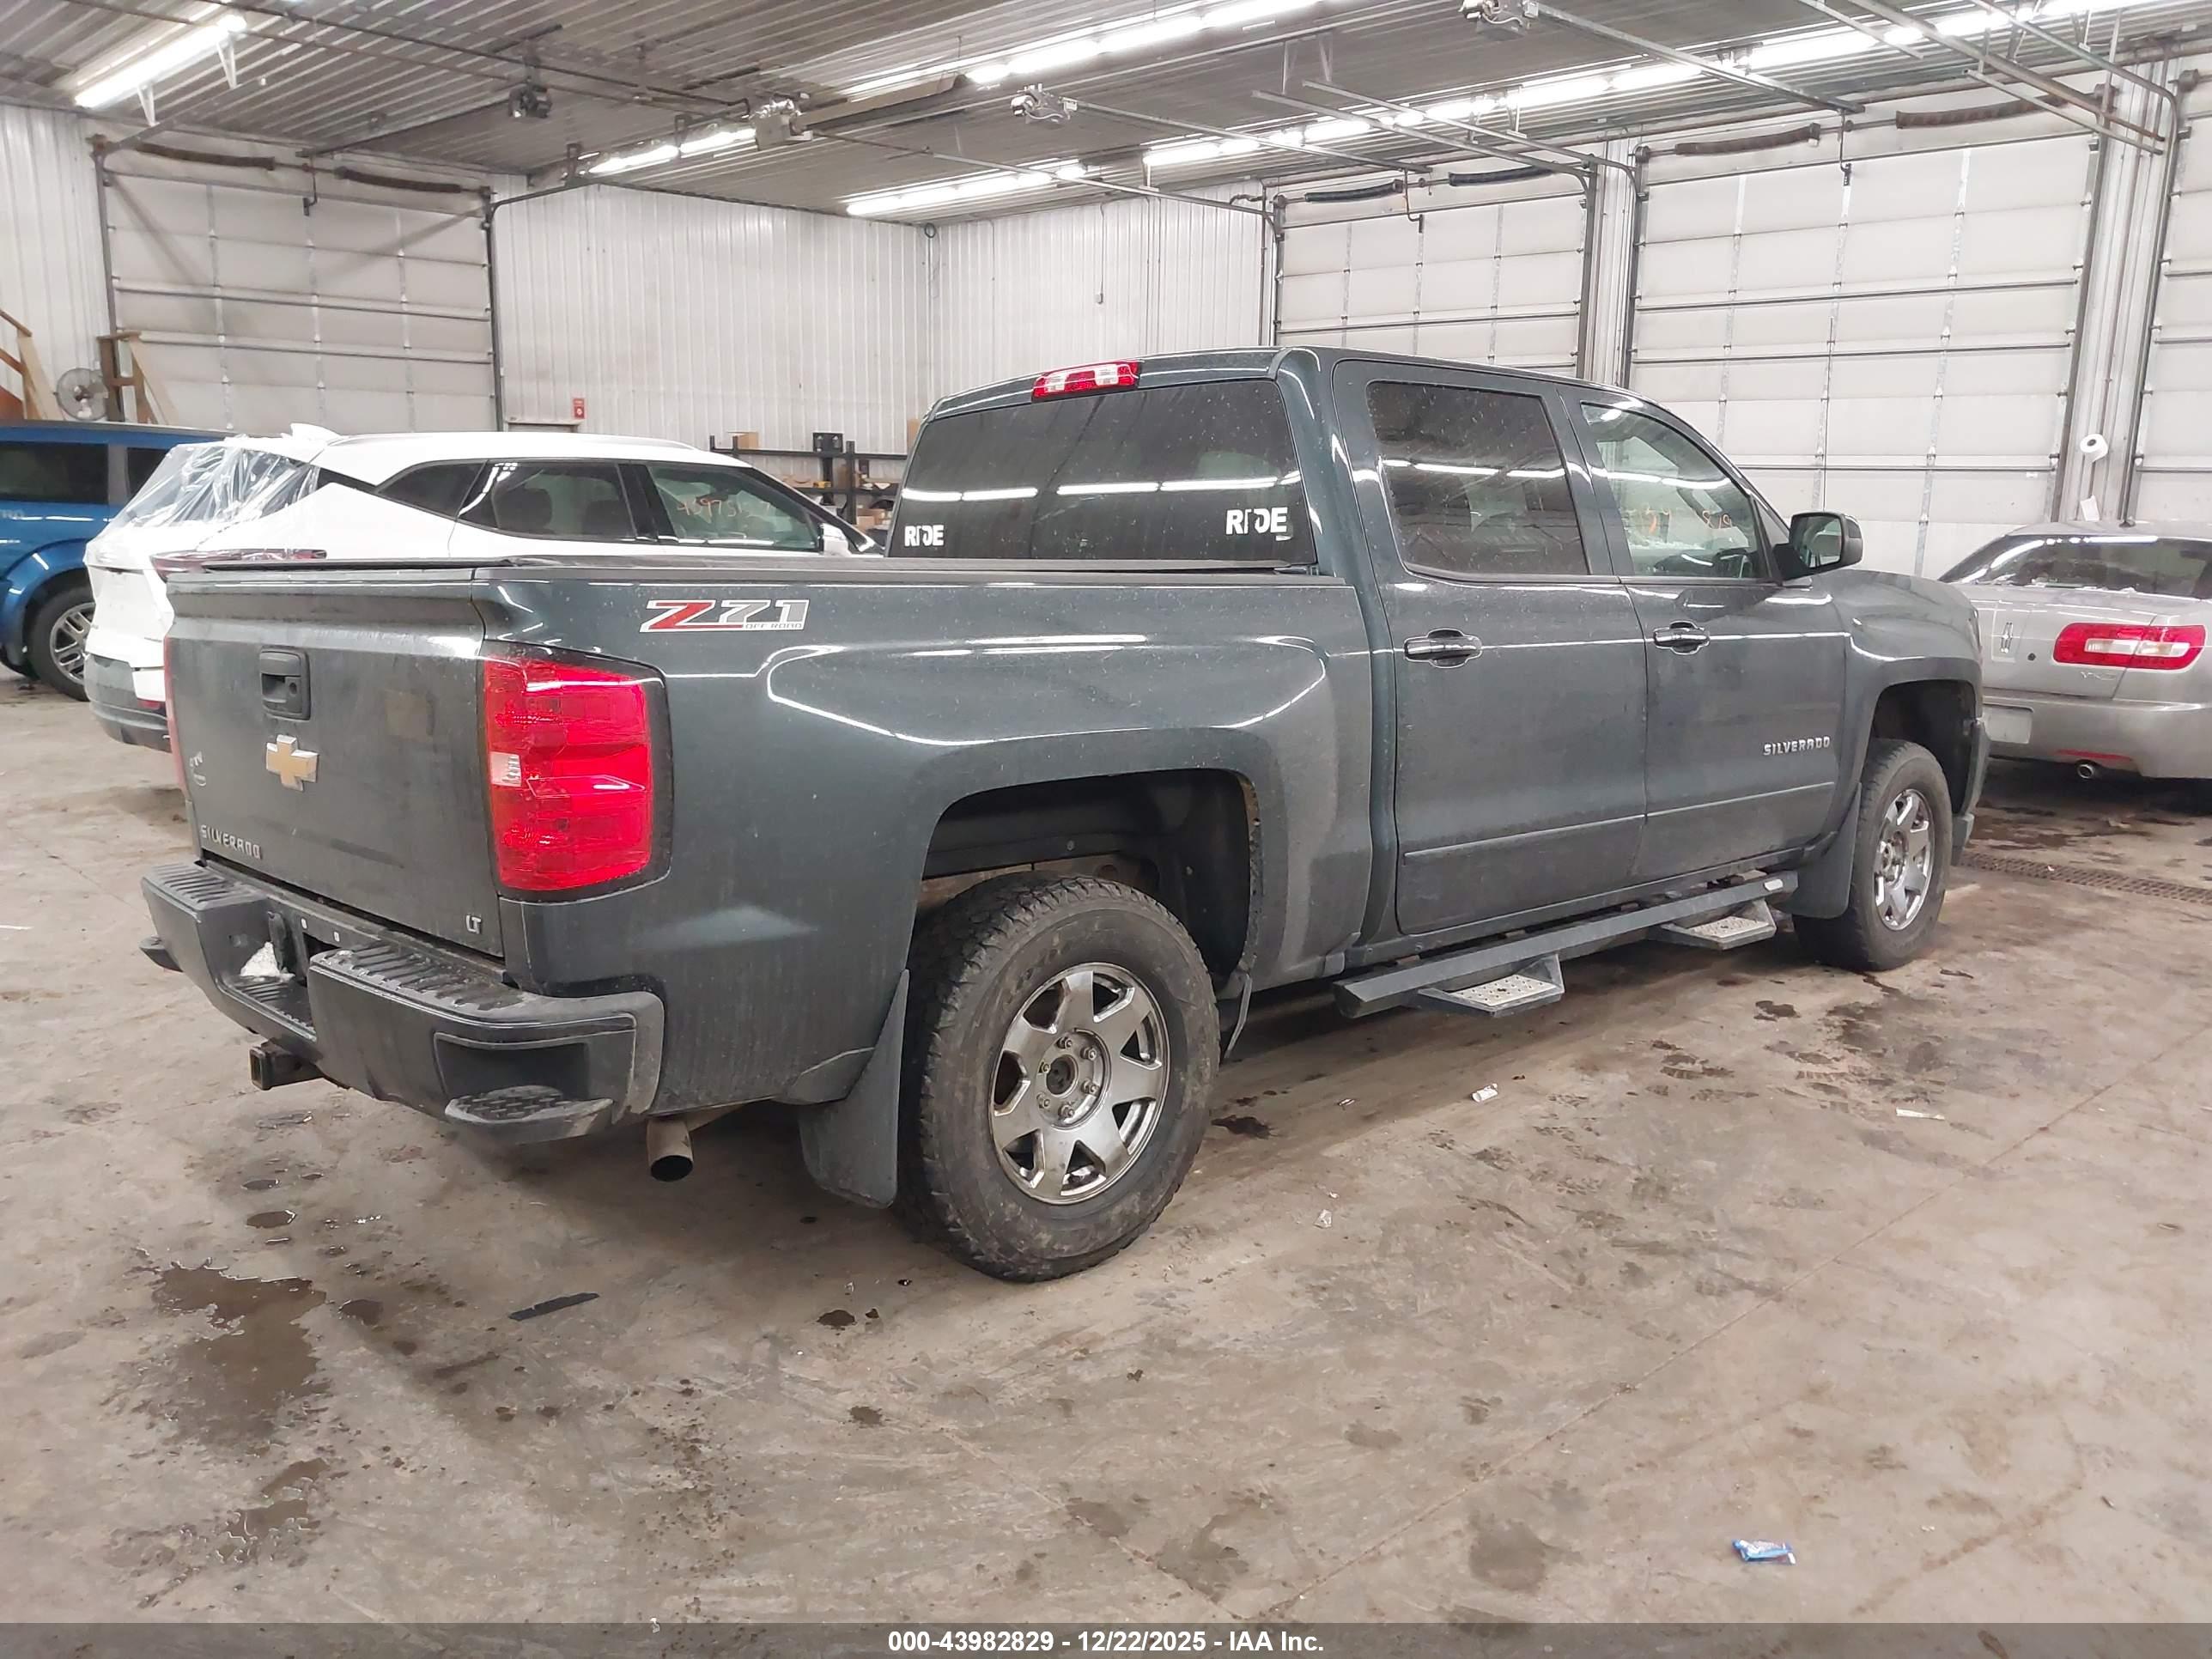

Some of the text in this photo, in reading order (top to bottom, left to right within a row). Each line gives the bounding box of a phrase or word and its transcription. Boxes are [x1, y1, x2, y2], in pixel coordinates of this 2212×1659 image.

[1225, 507, 1288, 535] RIDE
[904, 524, 945, 547] RIDE
[640, 599, 810, 633] Z71
[1763, 736, 1831, 756] SILVERADO
[200, 824, 262, 860] SILVERADO
[465, 915, 482, 935] LT
